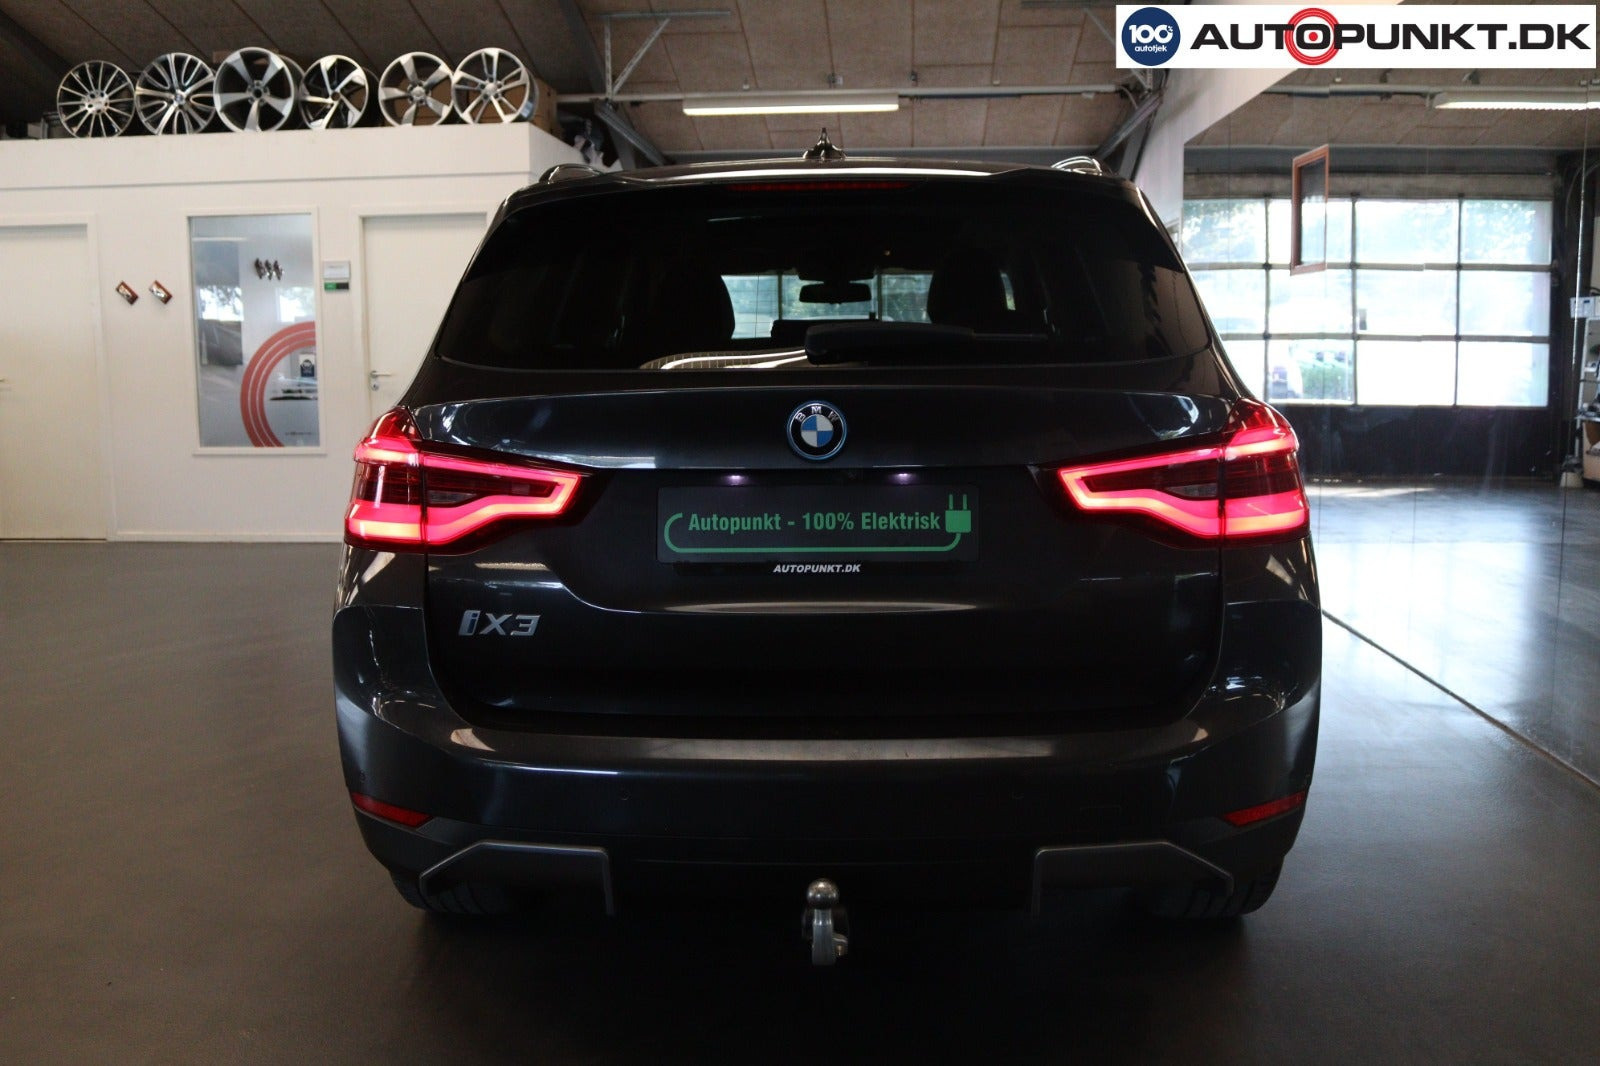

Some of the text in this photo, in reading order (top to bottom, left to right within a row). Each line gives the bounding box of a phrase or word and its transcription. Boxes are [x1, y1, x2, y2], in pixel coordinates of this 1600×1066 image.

[795, 406, 840, 422] BMW
[688, 512, 781, 534] Autopunkt
[802, 512, 854, 531] 100%
[861, 511, 941, 530] Elektrisk
[773, 563, 861, 573] AUTOPUNKT.DK
